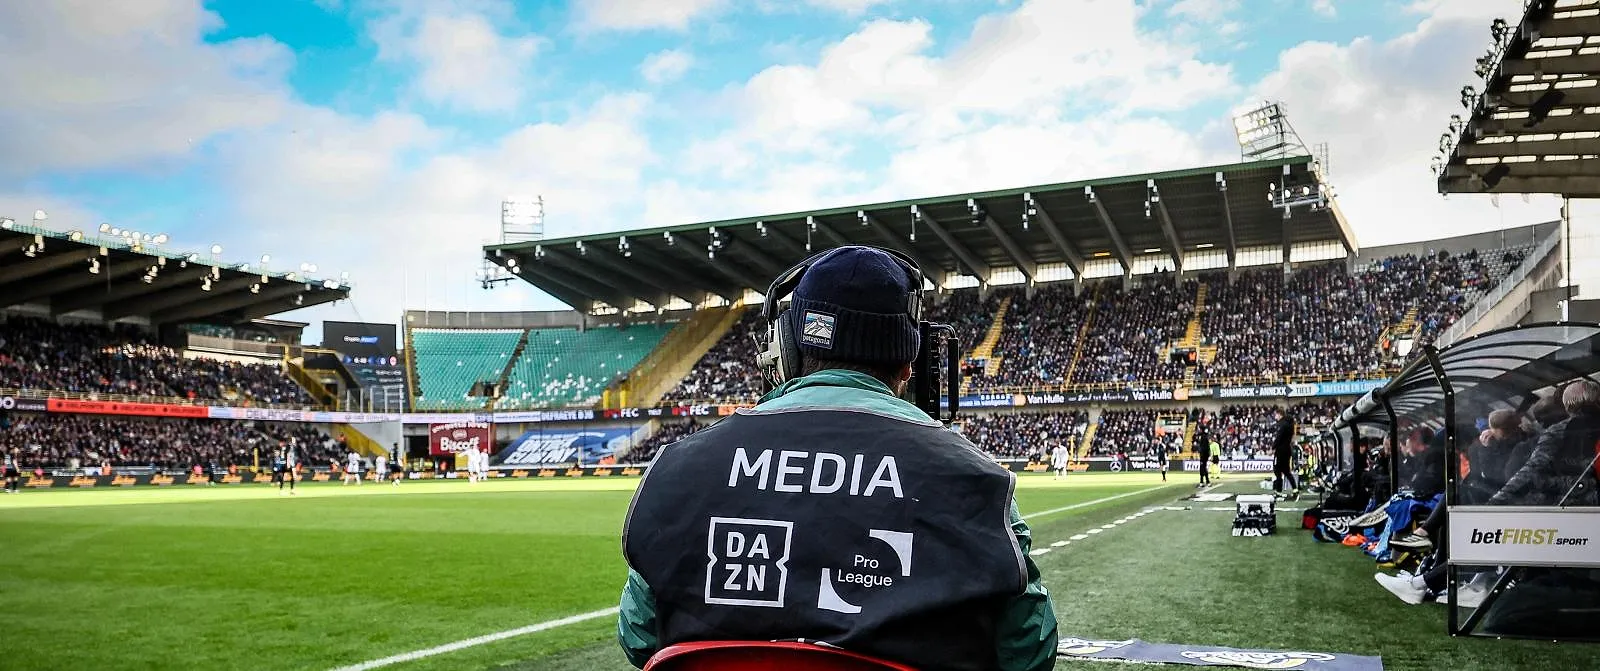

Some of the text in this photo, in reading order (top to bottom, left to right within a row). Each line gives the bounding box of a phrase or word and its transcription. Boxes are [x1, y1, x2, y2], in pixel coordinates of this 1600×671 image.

[1132, 390, 1172, 400] Van Hulle
[1220, 387, 1254, 397] SHAMROCK
[1027, 393, 1064, 404] Van Hulle
[621, 408, 639, 417] FEC
[690, 405, 709, 415] FEC
[1245, 461, 1272, 470] Hubo
[728, 447, 904, 498] MEDIA
[854, 554, 879, 568] Pro
[837, 568, 893, 587] League
